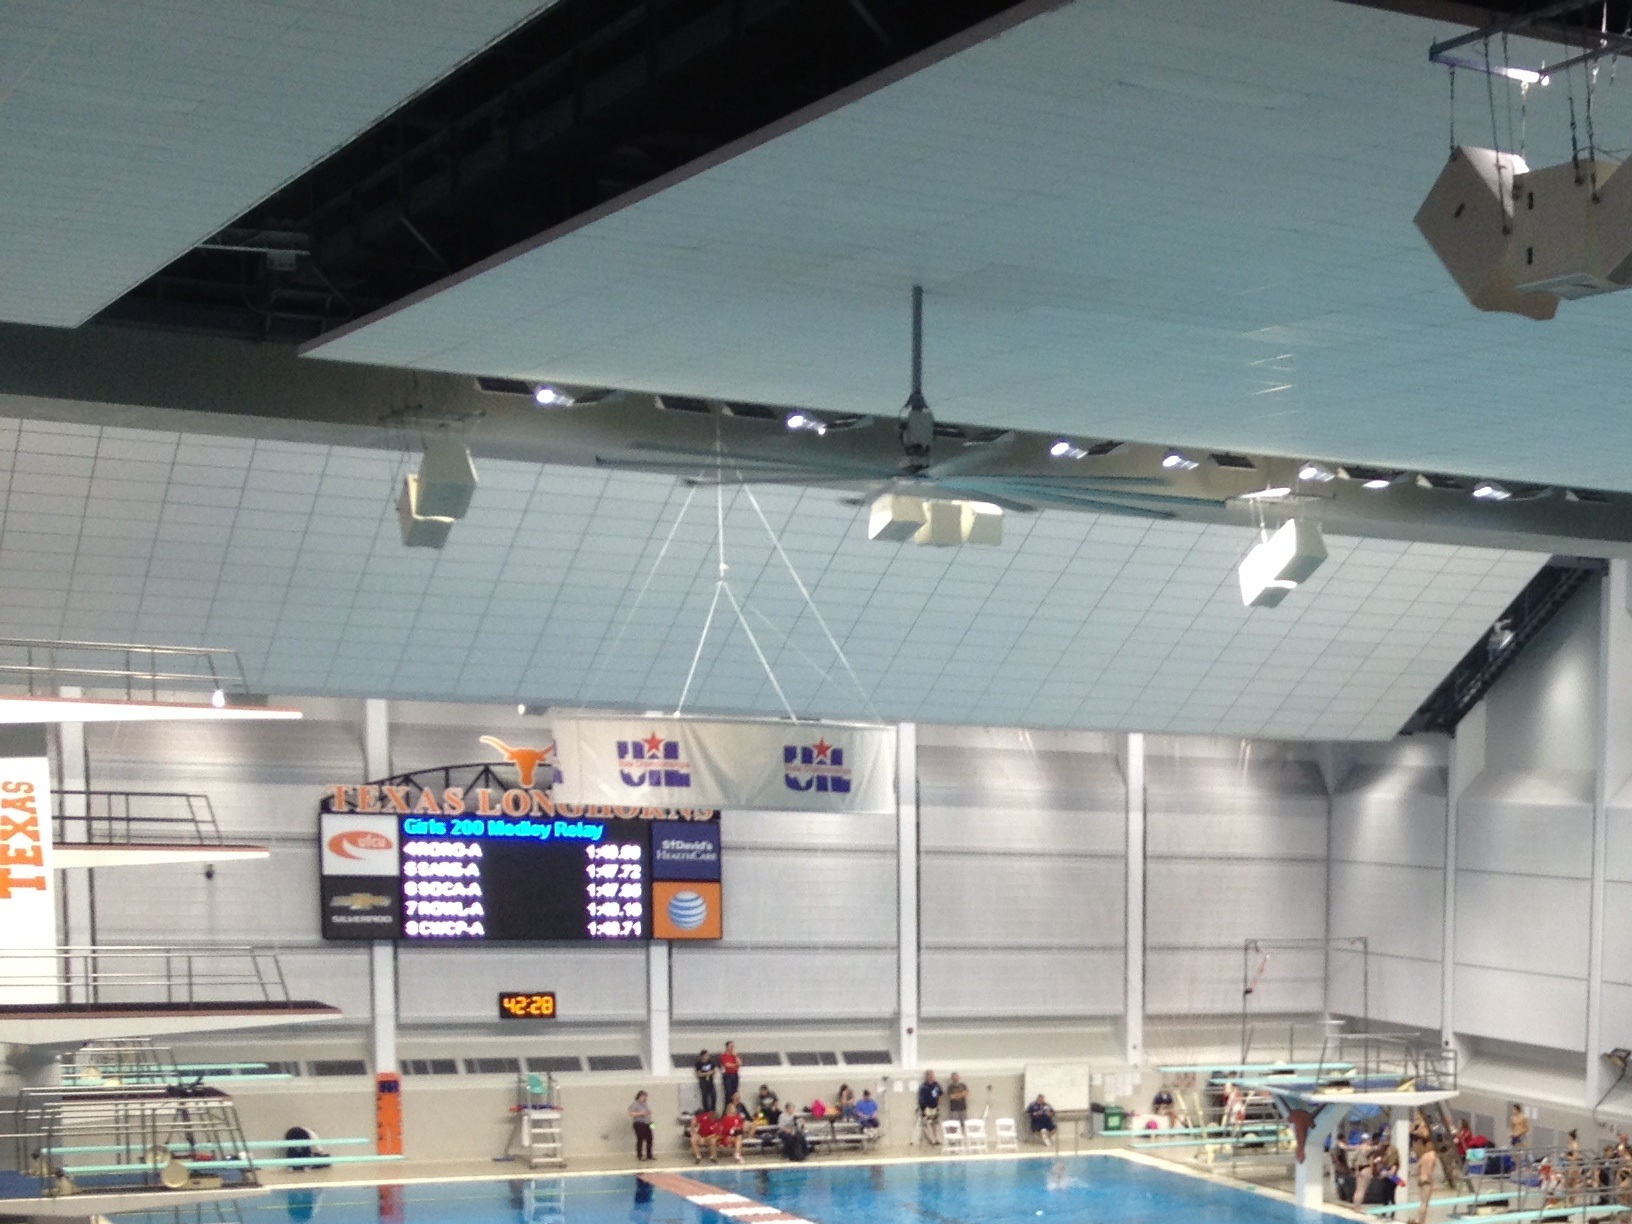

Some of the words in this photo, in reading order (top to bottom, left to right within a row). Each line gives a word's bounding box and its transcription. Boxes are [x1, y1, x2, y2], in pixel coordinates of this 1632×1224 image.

[330, 784, 465, 815] TEXAS
[0, 781, 46, 899] TEXAS
[404, 818, 446, 834] Girls
[450, 819, 484, 835] 200
[488, 820, 551, 839] Medley
[555, 821, 603, 840] Relay
[503, 996, 554, 1015] 42:28
